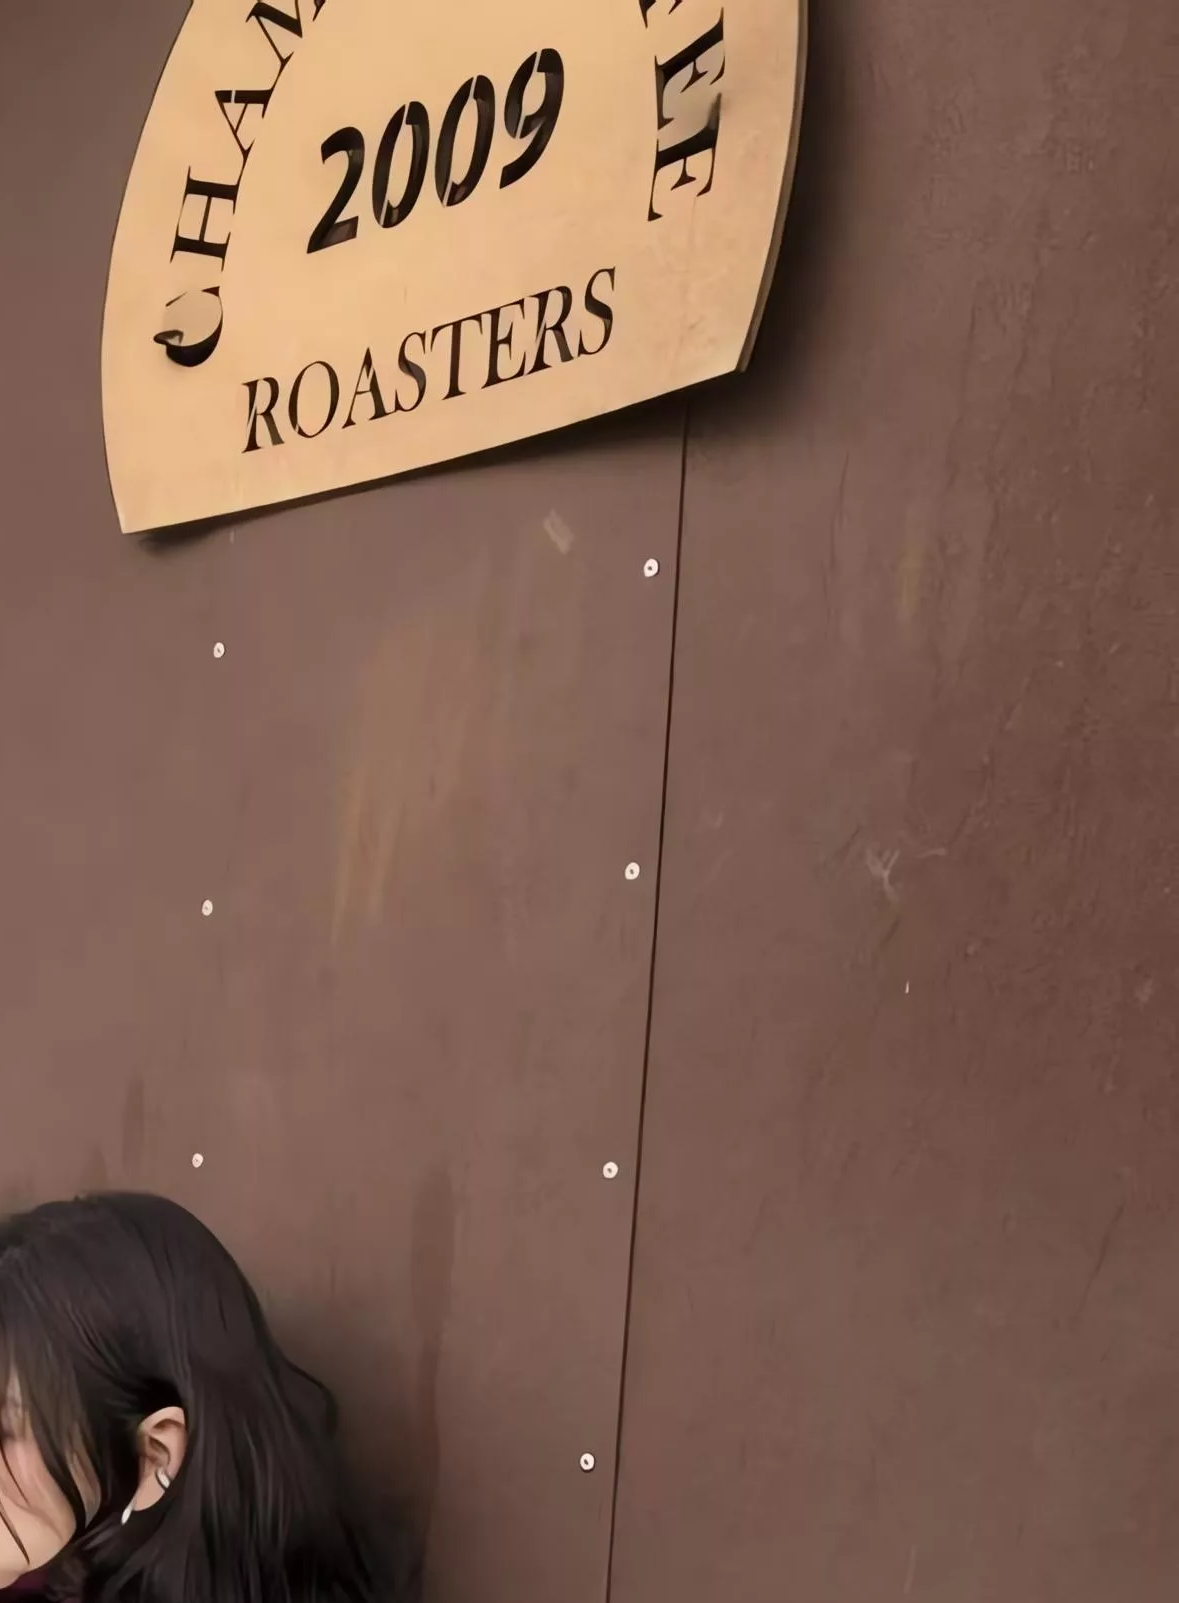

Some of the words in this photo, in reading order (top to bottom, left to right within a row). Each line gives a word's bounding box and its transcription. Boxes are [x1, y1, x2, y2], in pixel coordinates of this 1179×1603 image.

[306, 47, 565, 254] 2009
[638, 0, 726, 222] EE
[241, 266, 617, 454] ROASTERS
